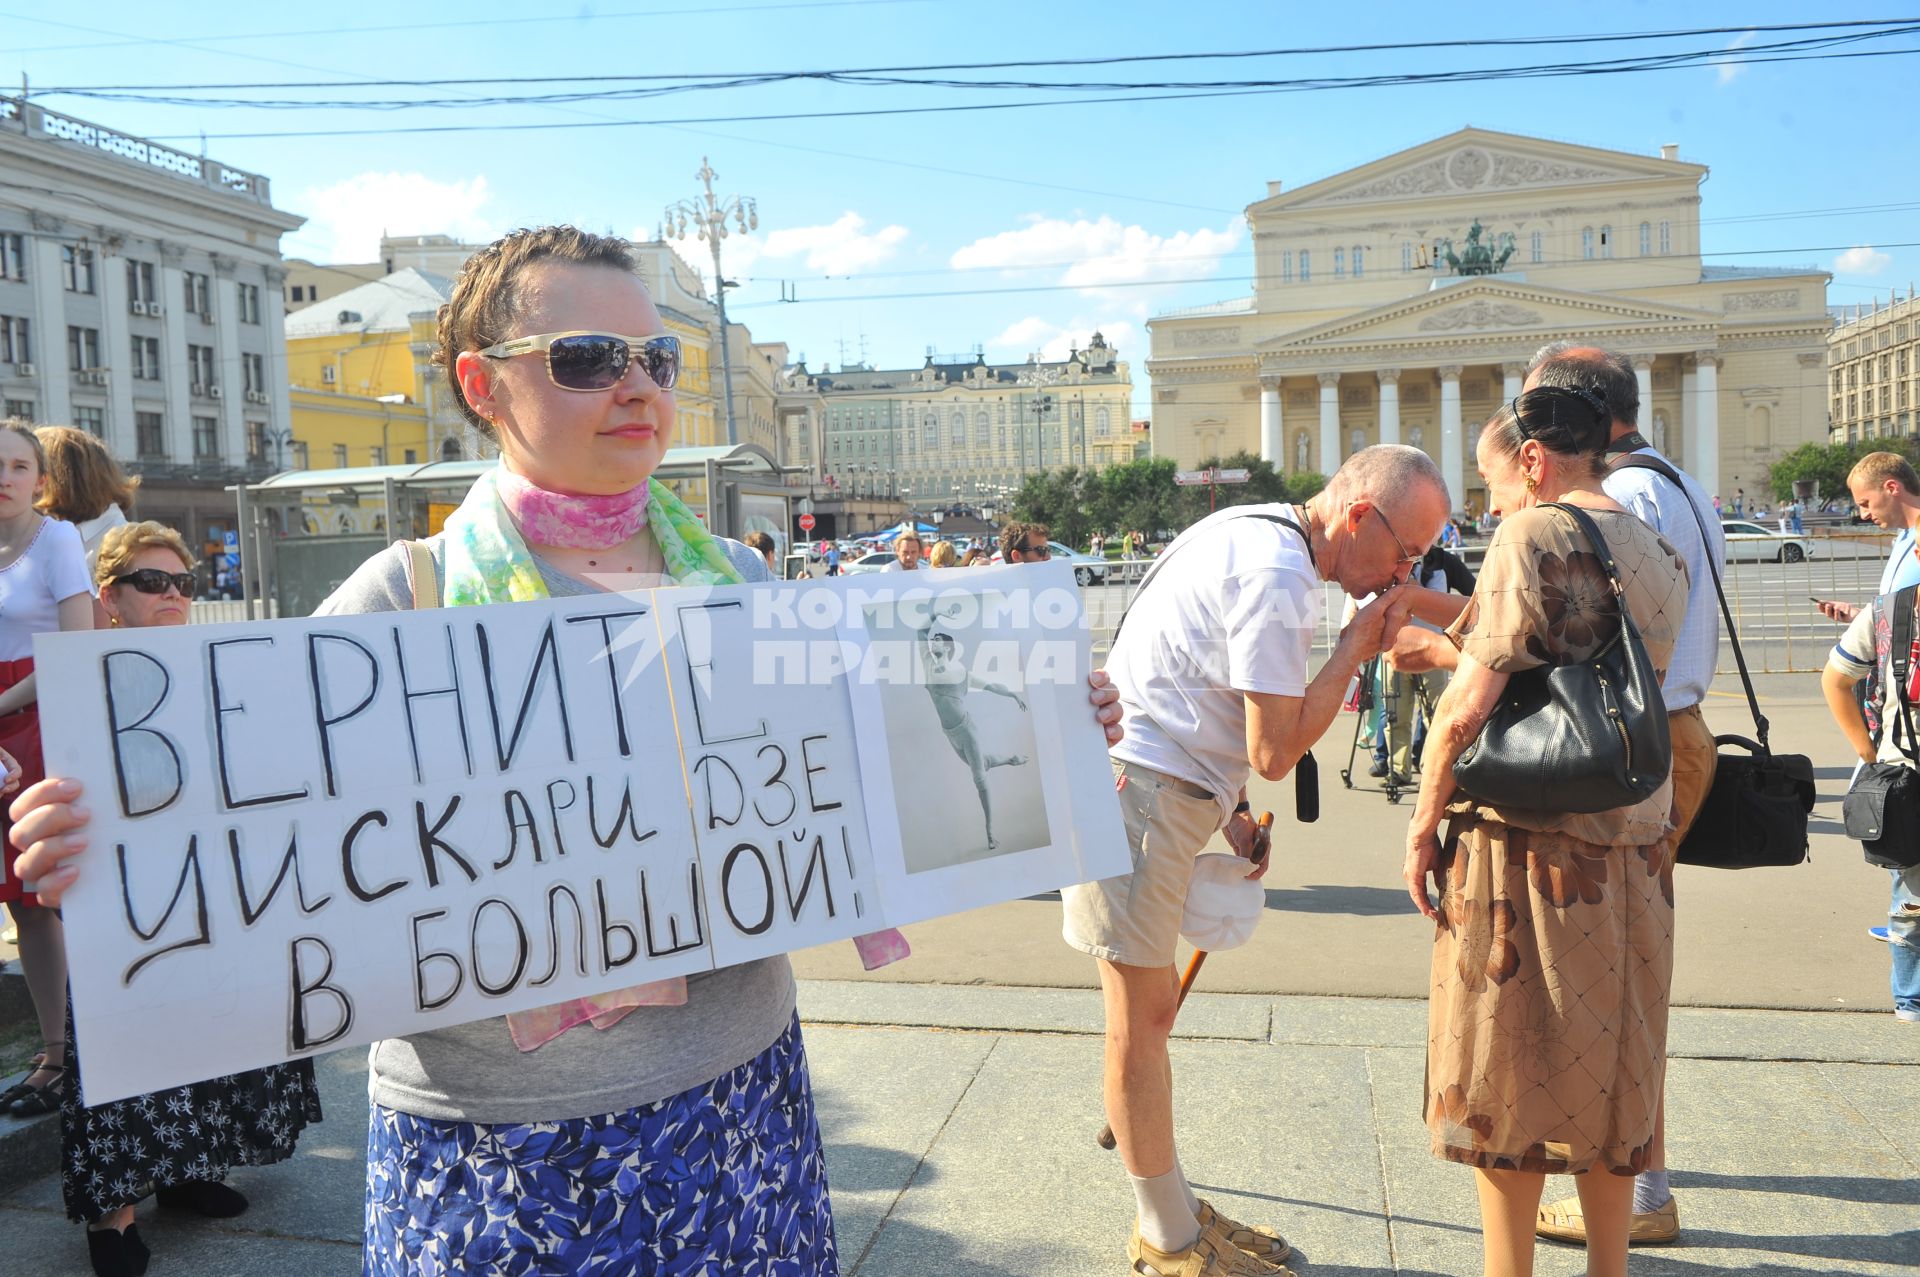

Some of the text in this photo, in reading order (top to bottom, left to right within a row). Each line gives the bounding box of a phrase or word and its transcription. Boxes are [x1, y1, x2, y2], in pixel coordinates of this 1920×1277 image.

[103, 602, 767, 817] ВЕРНИТЕ
[291, 826, 860, 1051] В БОЛЬШОЙ!
